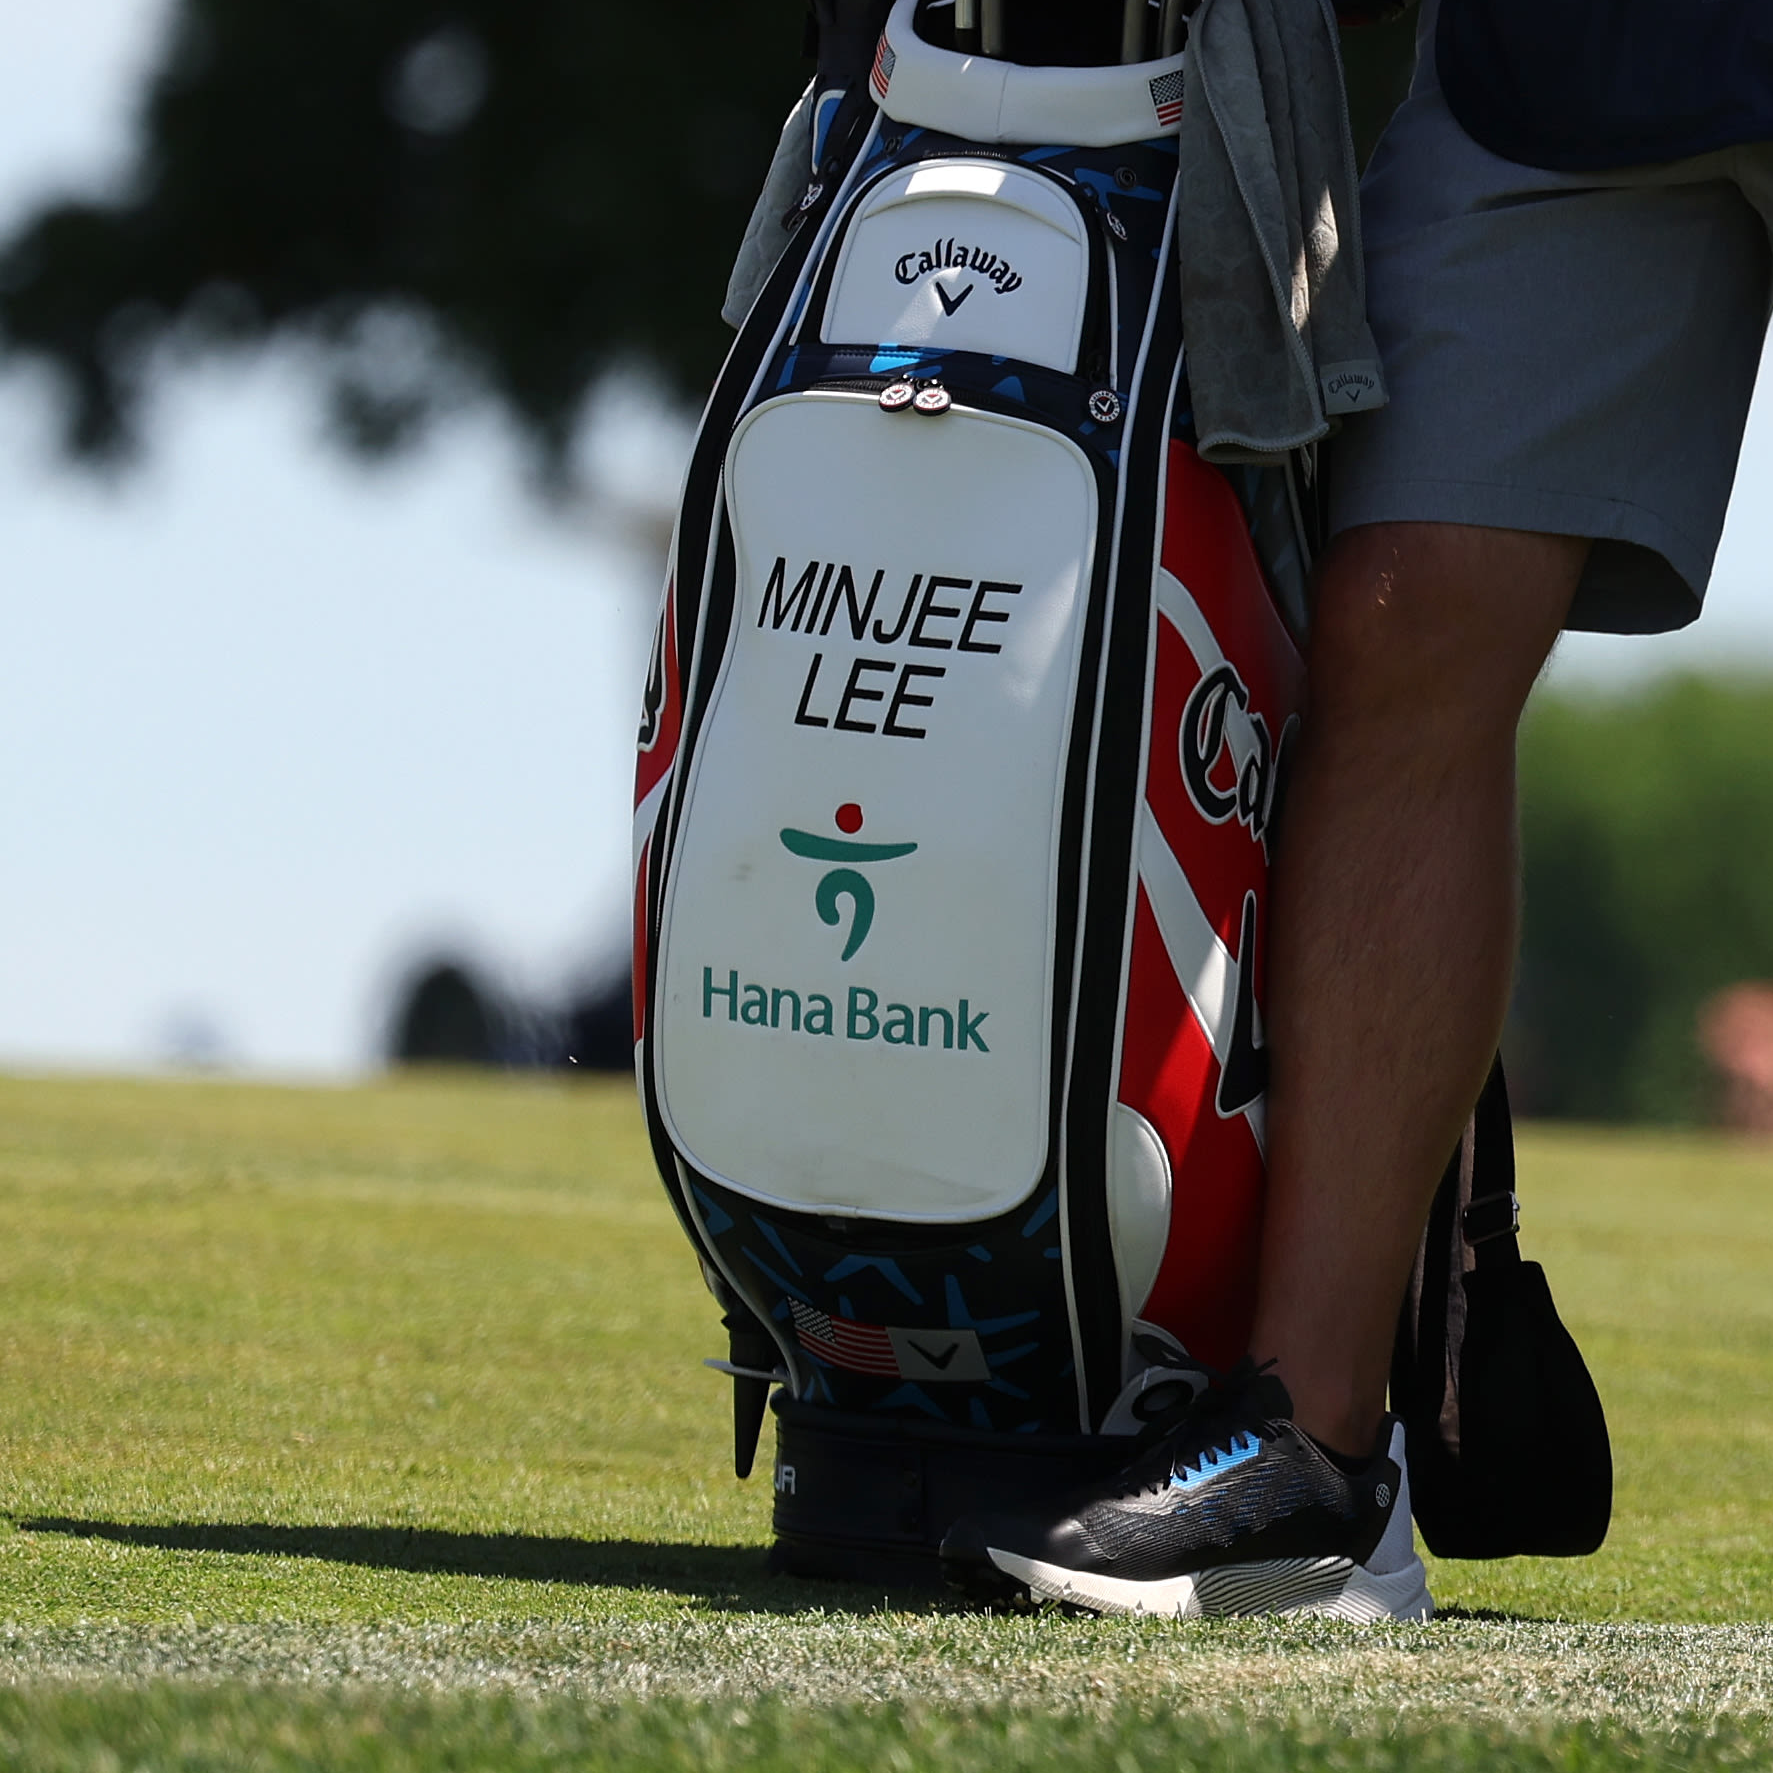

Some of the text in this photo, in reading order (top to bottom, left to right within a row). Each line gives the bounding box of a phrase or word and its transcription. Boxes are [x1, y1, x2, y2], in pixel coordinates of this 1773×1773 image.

[895, 237, 1022, 295] Callaway
[1328, 373, 1375, 395] Callaway
[757, 556, 1023, 654] MINJEE
[794, 653, 946, 739] LEE
[702, 966, 991, 1053] Hana Bank
